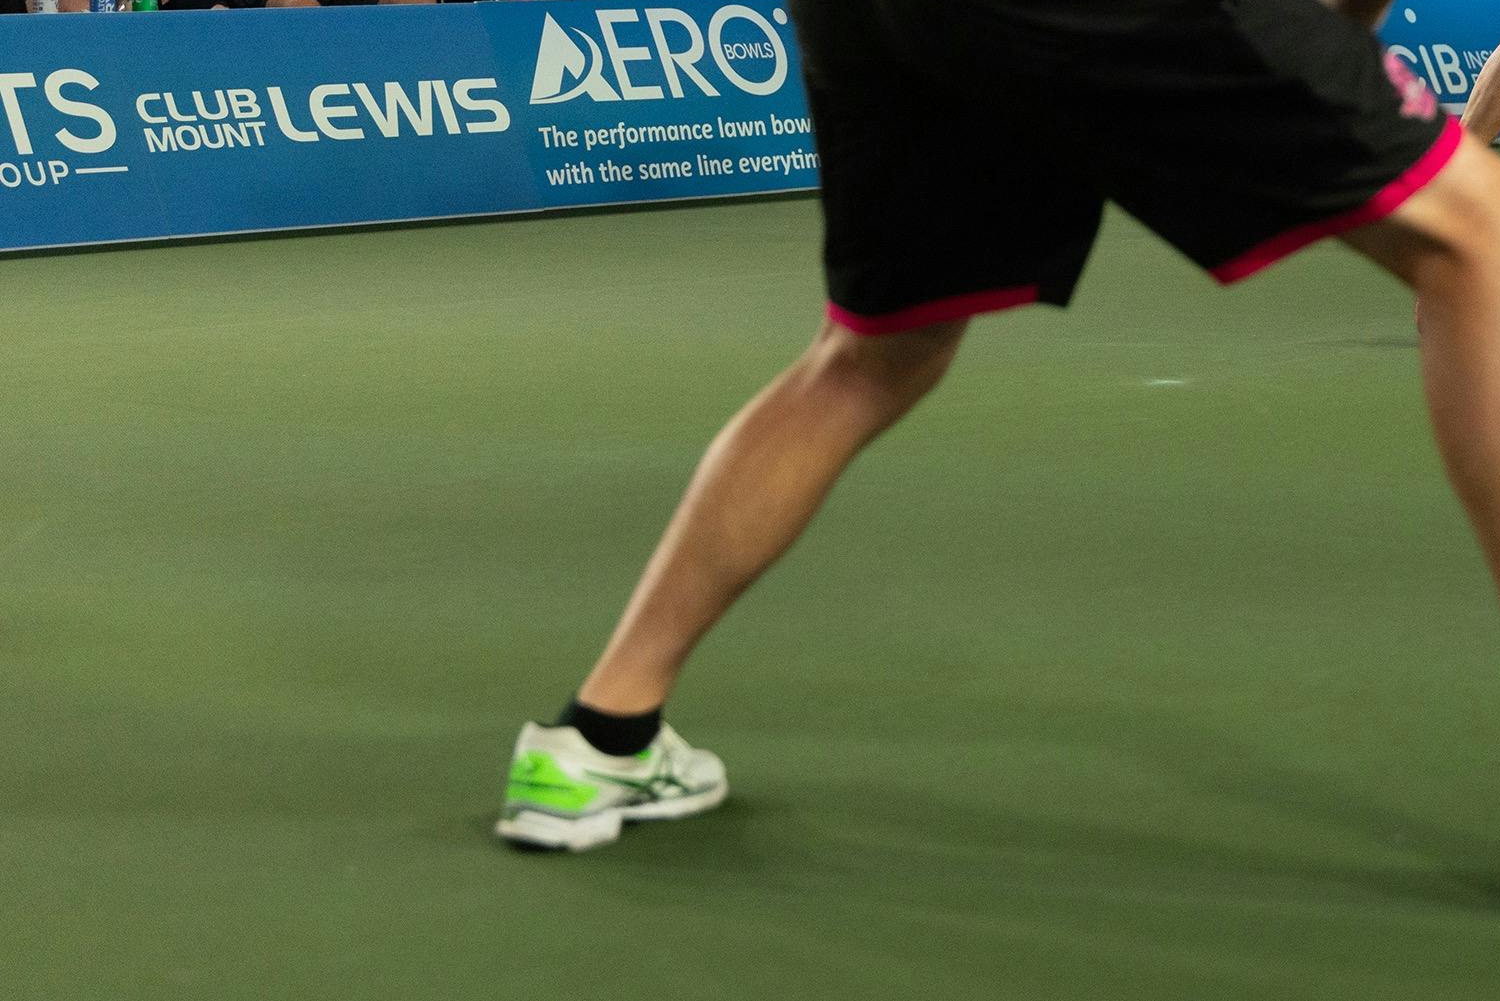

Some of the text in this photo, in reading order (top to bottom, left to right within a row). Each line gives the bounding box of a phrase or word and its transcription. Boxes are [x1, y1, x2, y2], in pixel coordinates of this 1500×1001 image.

[529, 4, 788, 105] AERO
[723, 42, 776, 61] BOWLS
[136, 88, 260, 124] CLUB
[267, 77, 511, 143] LEWIS
[144, 121, 266, 153] MOUNT
[538, 125, 578, 149] The
[584, 121, 713, 151] performance
[717, 116, 767, 139] lawn
[546, 161, 595, 187] with
[598, 159, 633, 183] the
[639, 159, 692, 181] same
[697, 153, 733, 177] line
